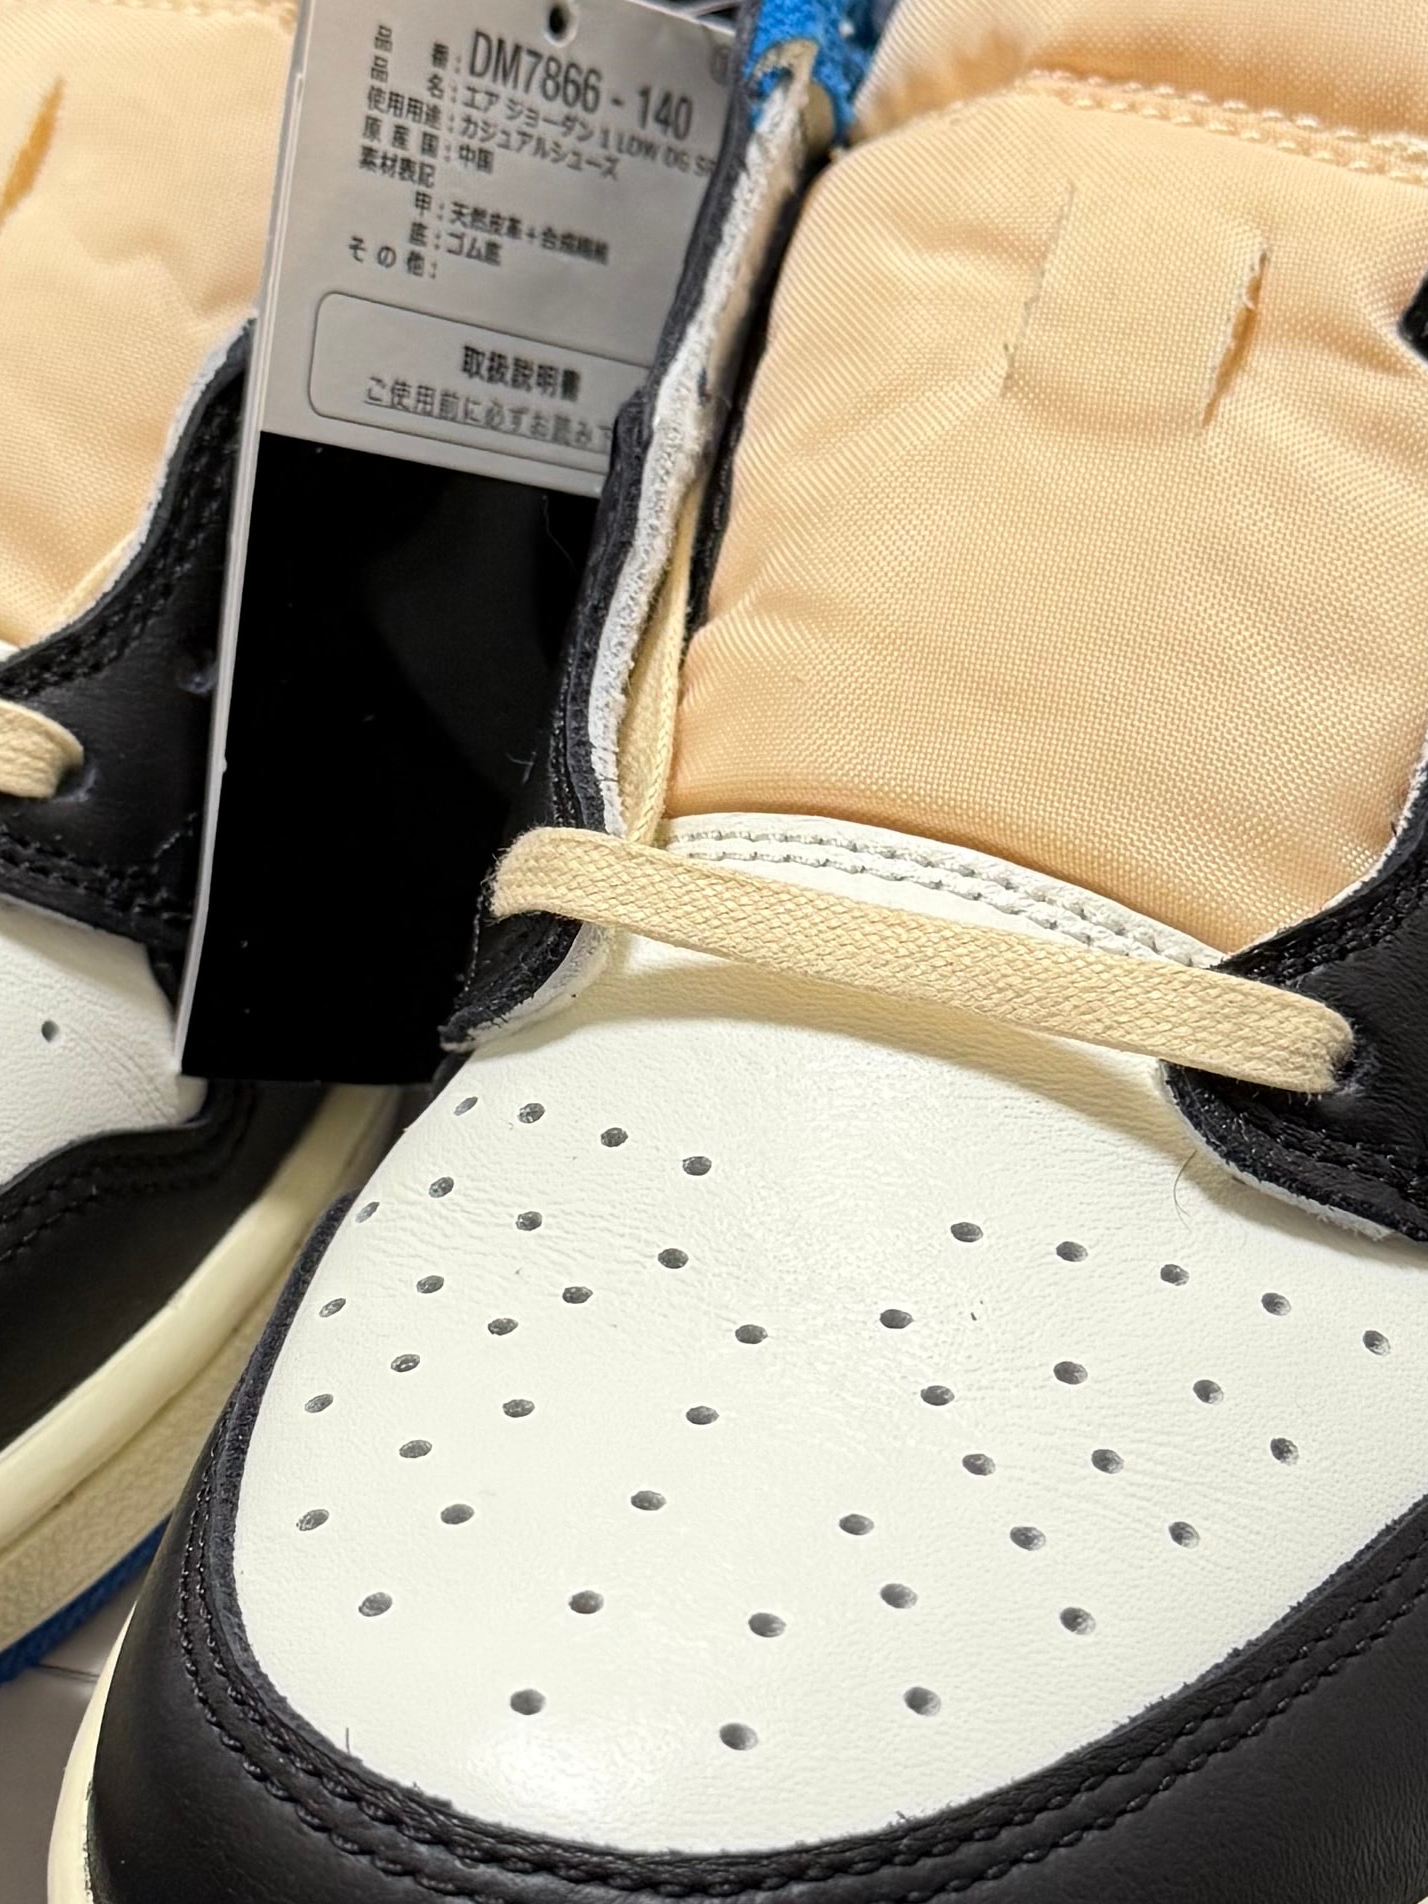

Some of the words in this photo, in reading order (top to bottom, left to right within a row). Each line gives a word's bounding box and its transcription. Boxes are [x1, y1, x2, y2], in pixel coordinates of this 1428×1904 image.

[468, 28, 601, 115] DM7866
[636, 85, 694, 142] 140
[458, 143, 495, 175] 中国
[460, 114, 620, 182] カジュアルシューズ
[462, 344, 582, 403] 取扱説明書
